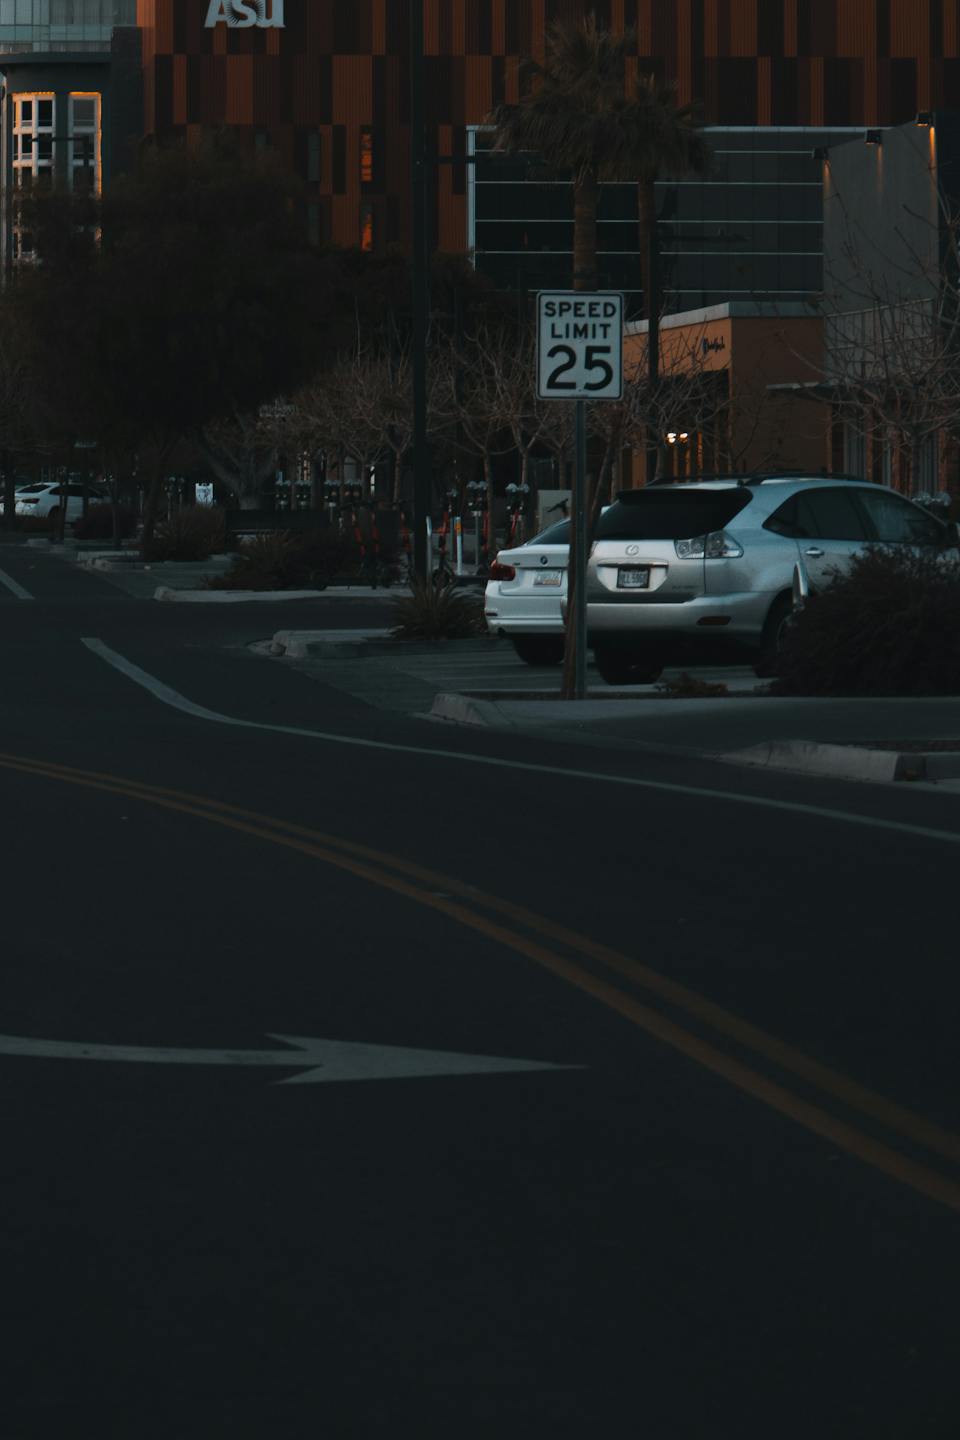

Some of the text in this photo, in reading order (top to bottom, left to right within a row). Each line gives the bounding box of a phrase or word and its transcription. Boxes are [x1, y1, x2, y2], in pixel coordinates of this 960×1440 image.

[544, 301, 616, 318] SPEED
[551, 323, 611, 339] LIMIT
[546, 345, 613, 391] 25
